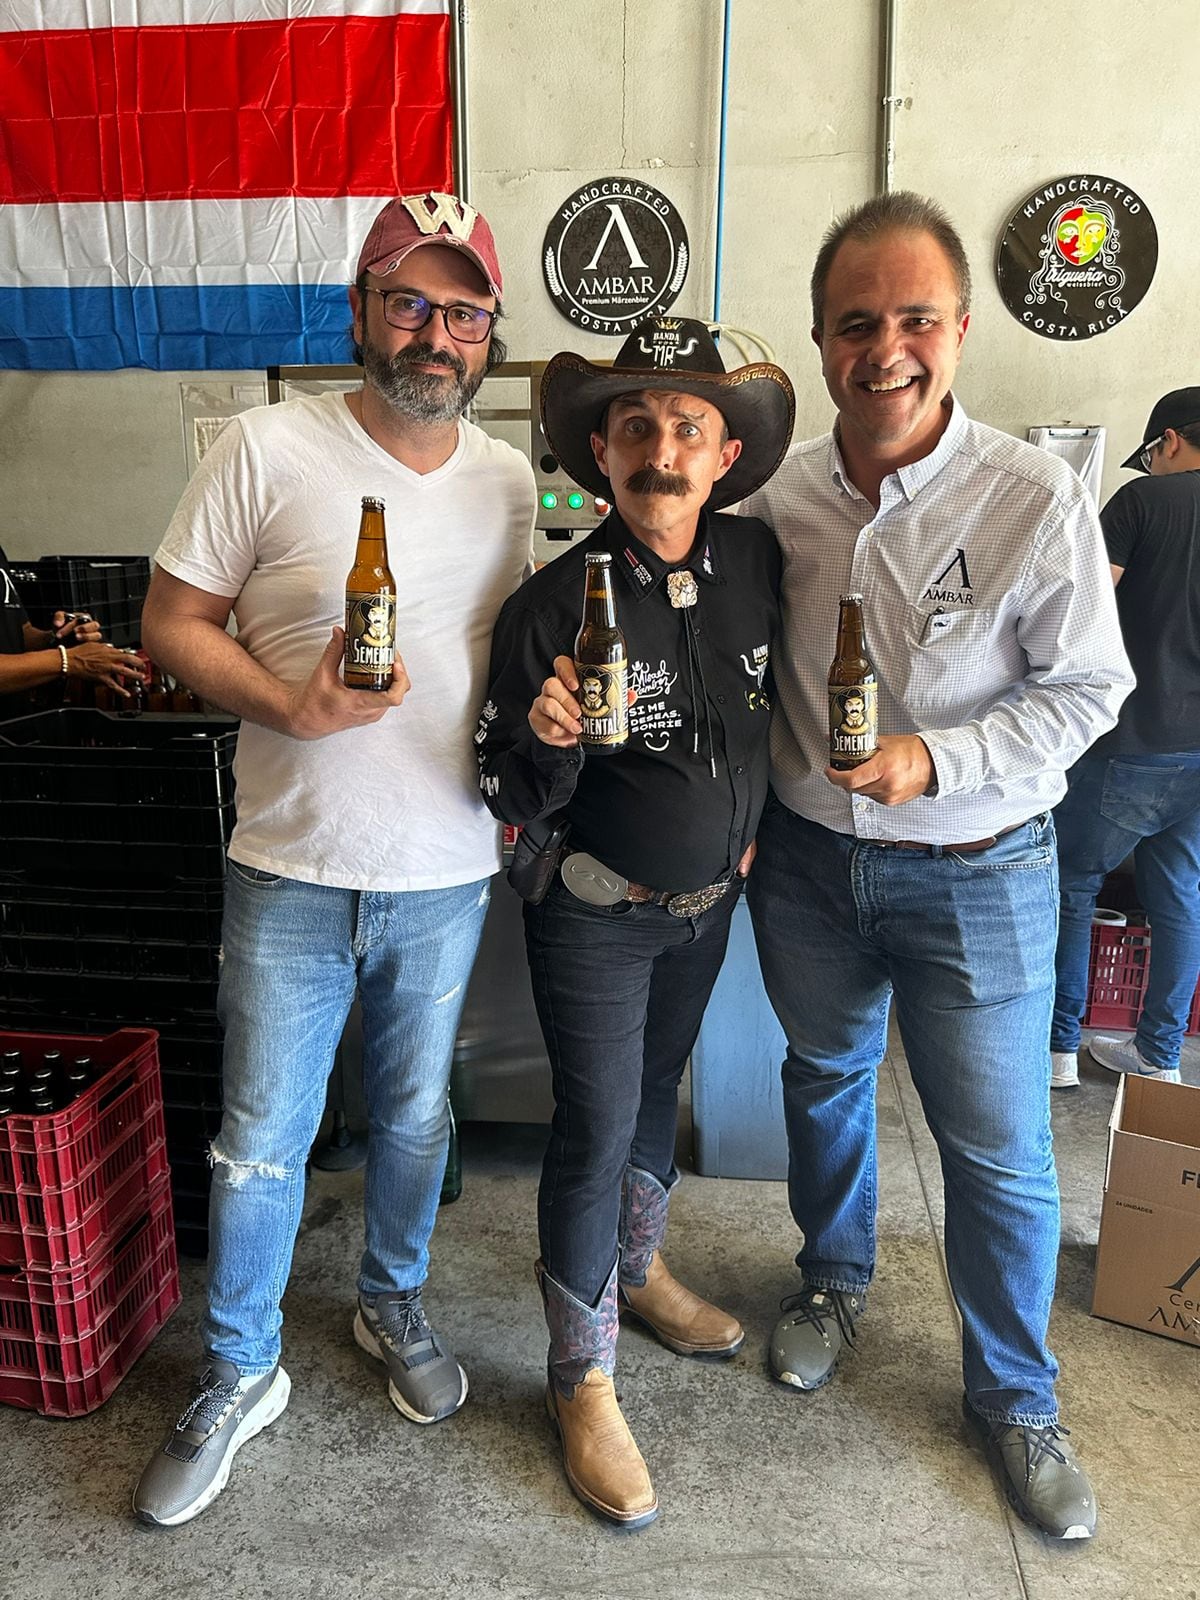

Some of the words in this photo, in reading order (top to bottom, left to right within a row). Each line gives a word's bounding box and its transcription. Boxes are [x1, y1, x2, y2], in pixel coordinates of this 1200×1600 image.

[561, 182, 670, 221] HANDCRAFTED
[1023, 179, 1141, 218] HANDCRAFTED
[401, 190, 478, 241] W
[575, 276, 657, 296] AMBAR
[581, 297, 610, 305] Premium
[569, 308, 622, 332] COSTA
[1023, 311, 1078, 337] COSTA
[1088, 307, 1128, 334] RICA
[653, 332, 680, 343] BANDA
[922, 588, 974, 606] AMBAR
[629, 705, 645, 717] SI
[647, 701, 666, 713] ME
